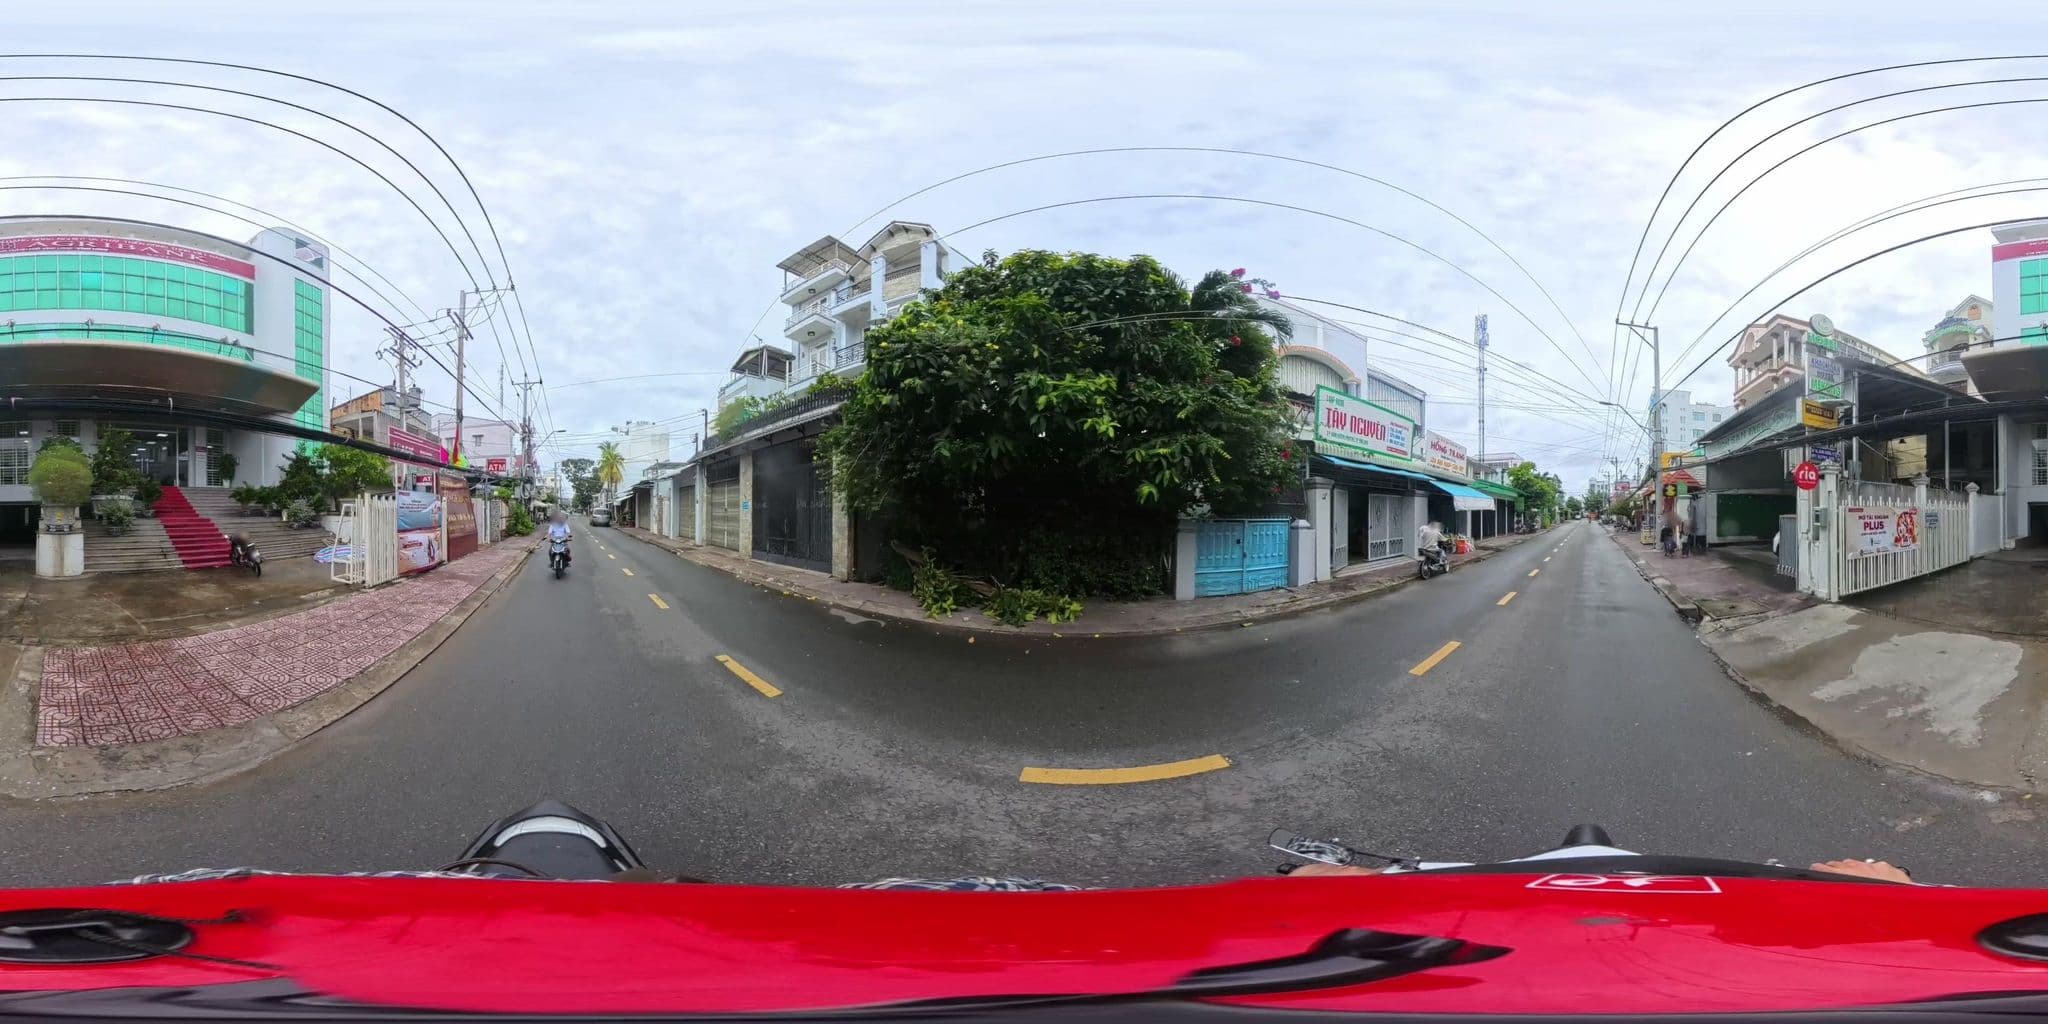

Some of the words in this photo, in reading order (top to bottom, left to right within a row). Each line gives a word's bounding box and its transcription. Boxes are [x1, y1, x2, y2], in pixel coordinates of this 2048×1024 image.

[26, 239, 208, 263] AGRIBANK
[1326, 407, 1347, 430] TÂY
[1350, 415, 1386, 441] NGUYÊN
[488, 462, 506, 472] ATM
[1798, 466, 1816, 480] ria
[1864, 521, 1885, 531] PLUS
